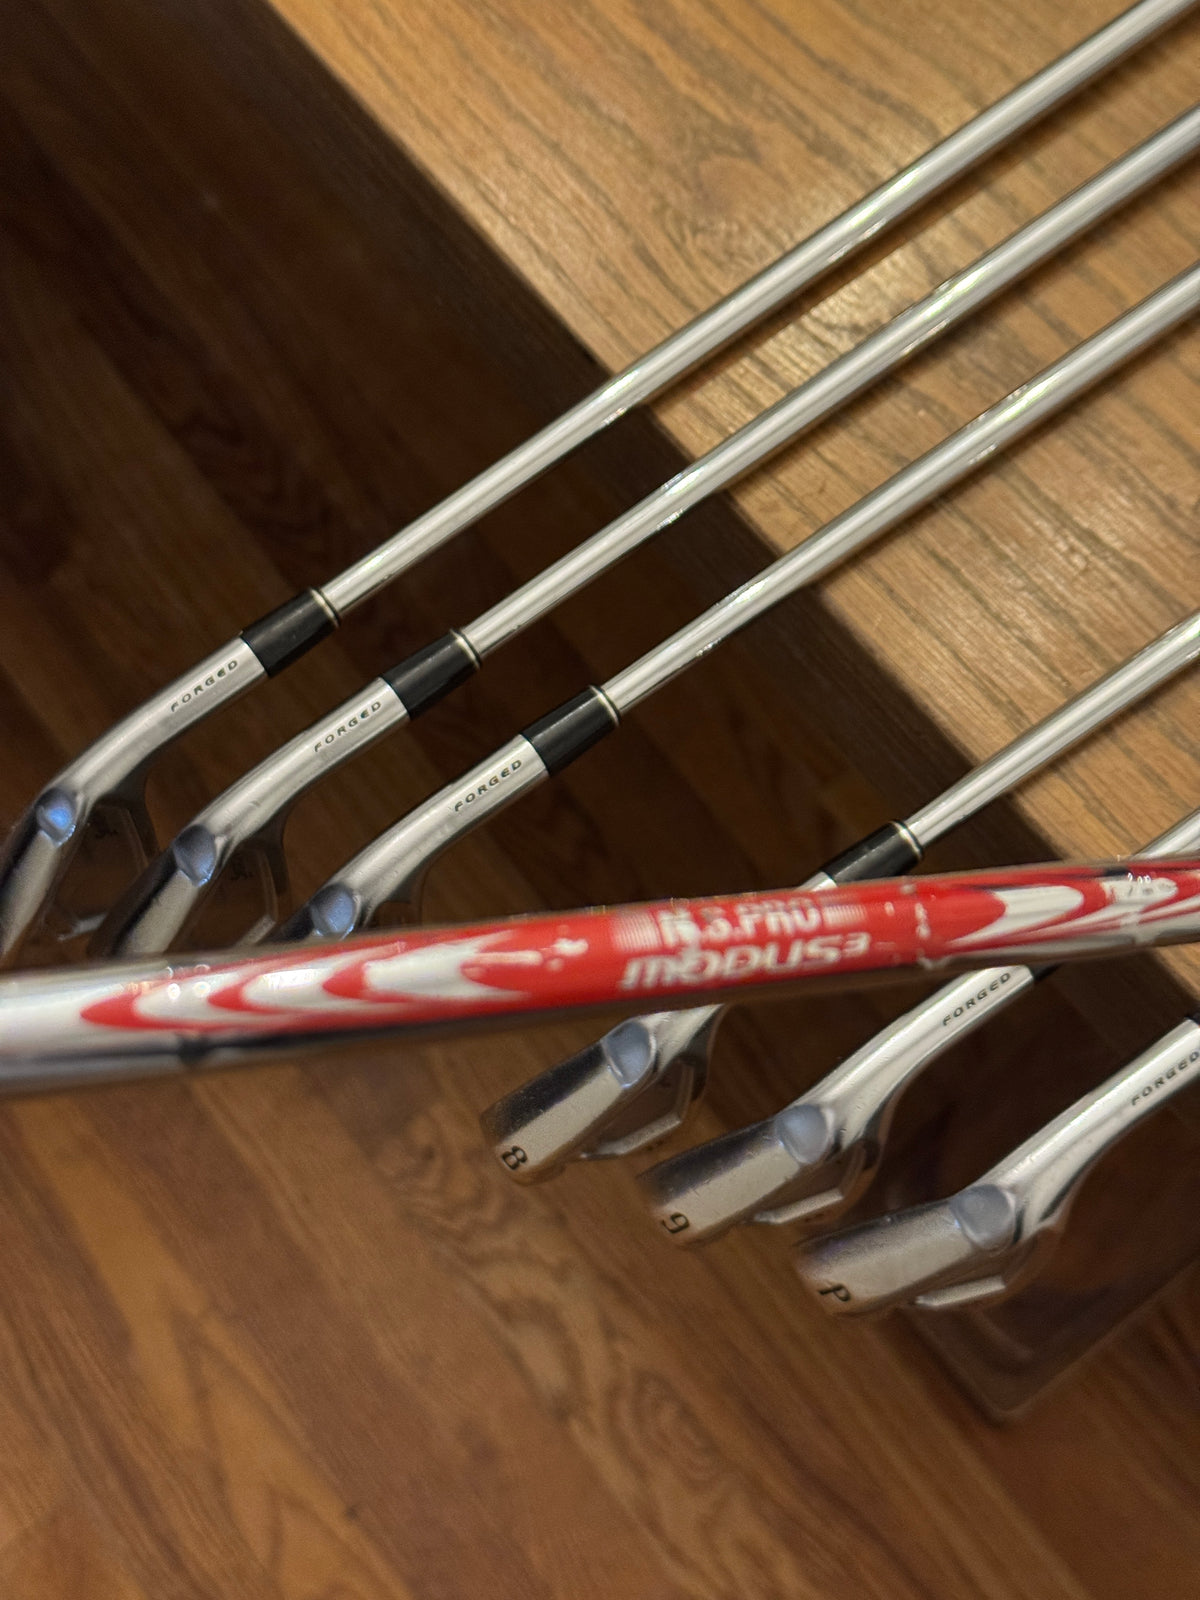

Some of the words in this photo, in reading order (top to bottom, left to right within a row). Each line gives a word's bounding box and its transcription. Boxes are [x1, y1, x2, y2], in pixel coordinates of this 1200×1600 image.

[170, 659, 239, 713] FORGED
[313, 700, 382, 753] FORGED
[453, 758, 523, 813] FORGED
[941, 971, 1011, 1026] FORGED
[1131, 1050, 1200, 1106] FORGED
[817, 1281, 853, 1304] P
